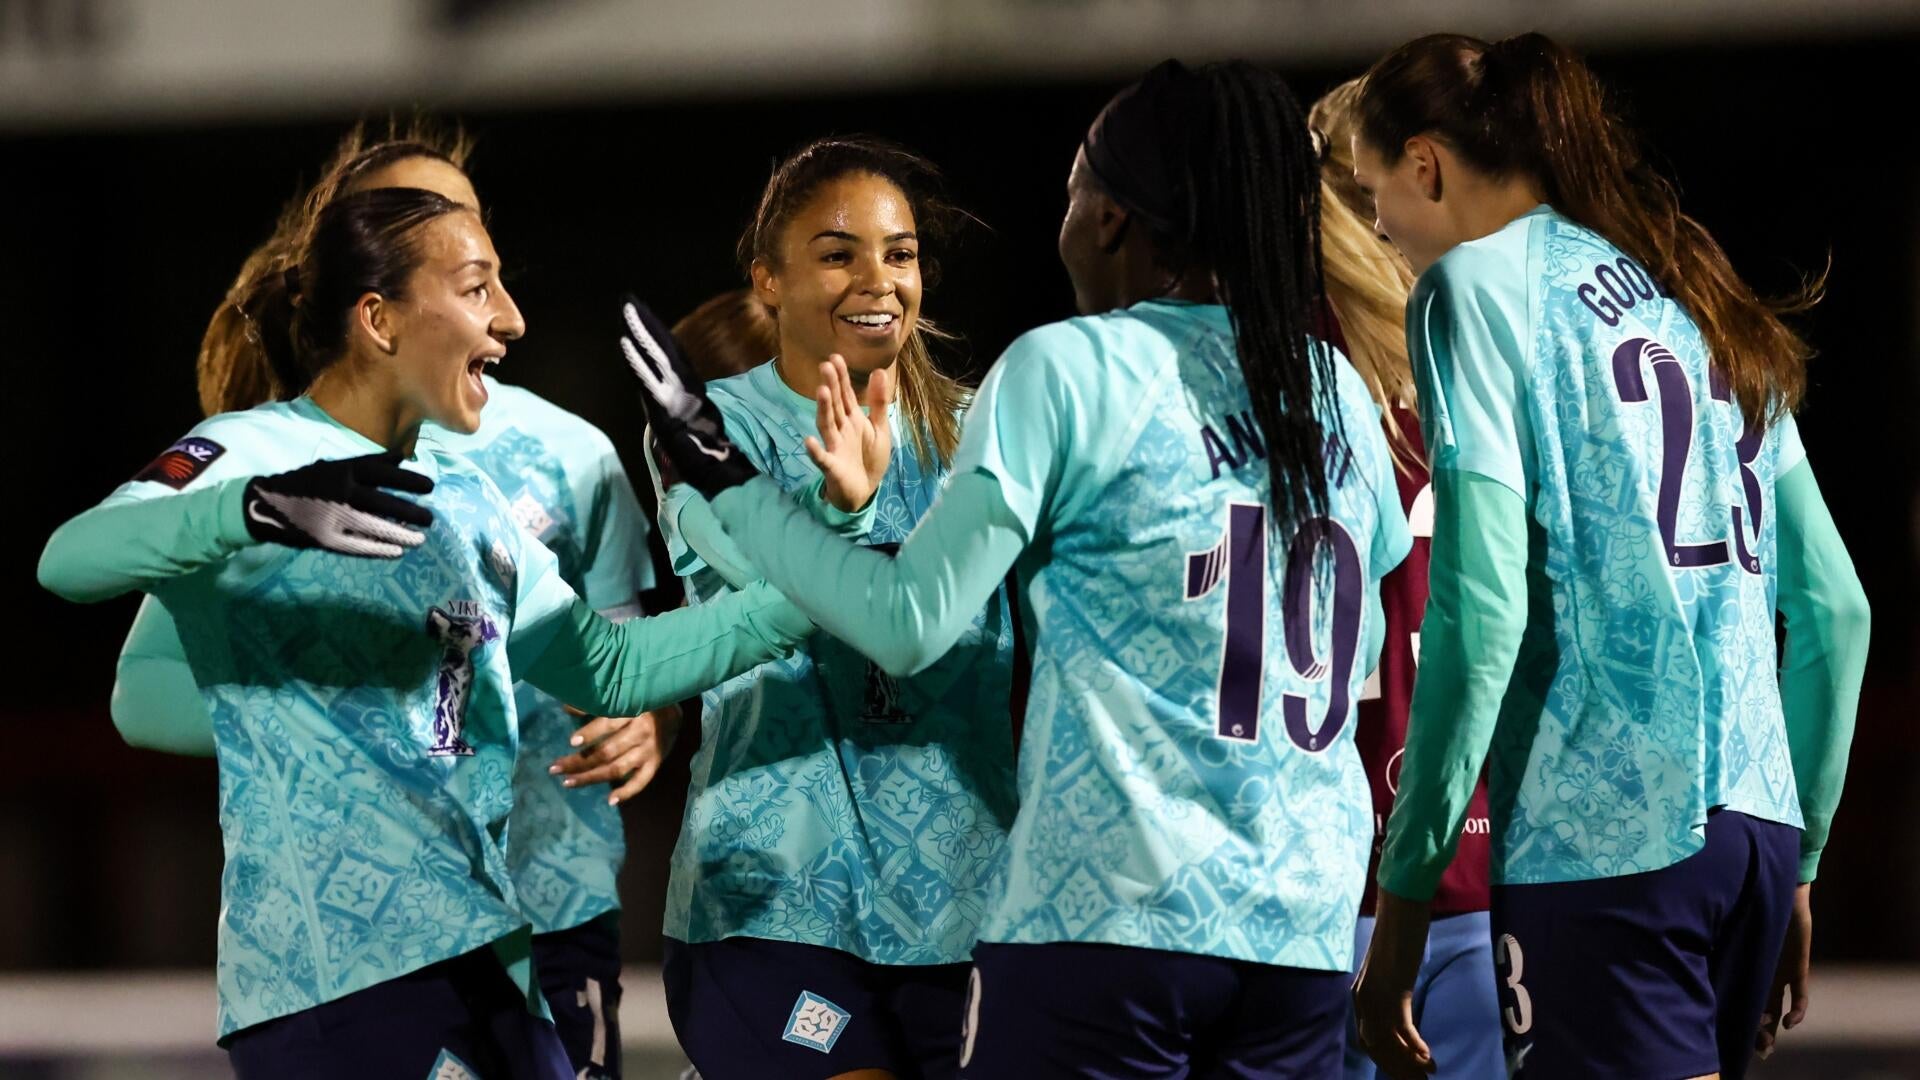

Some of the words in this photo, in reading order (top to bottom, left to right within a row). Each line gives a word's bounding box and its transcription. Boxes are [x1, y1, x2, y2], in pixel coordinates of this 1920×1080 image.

[1611, 337, 1764, 576] 23
[1183, 501, 1363, 753] 19
[1497, 932, 1533, 1035] 3
